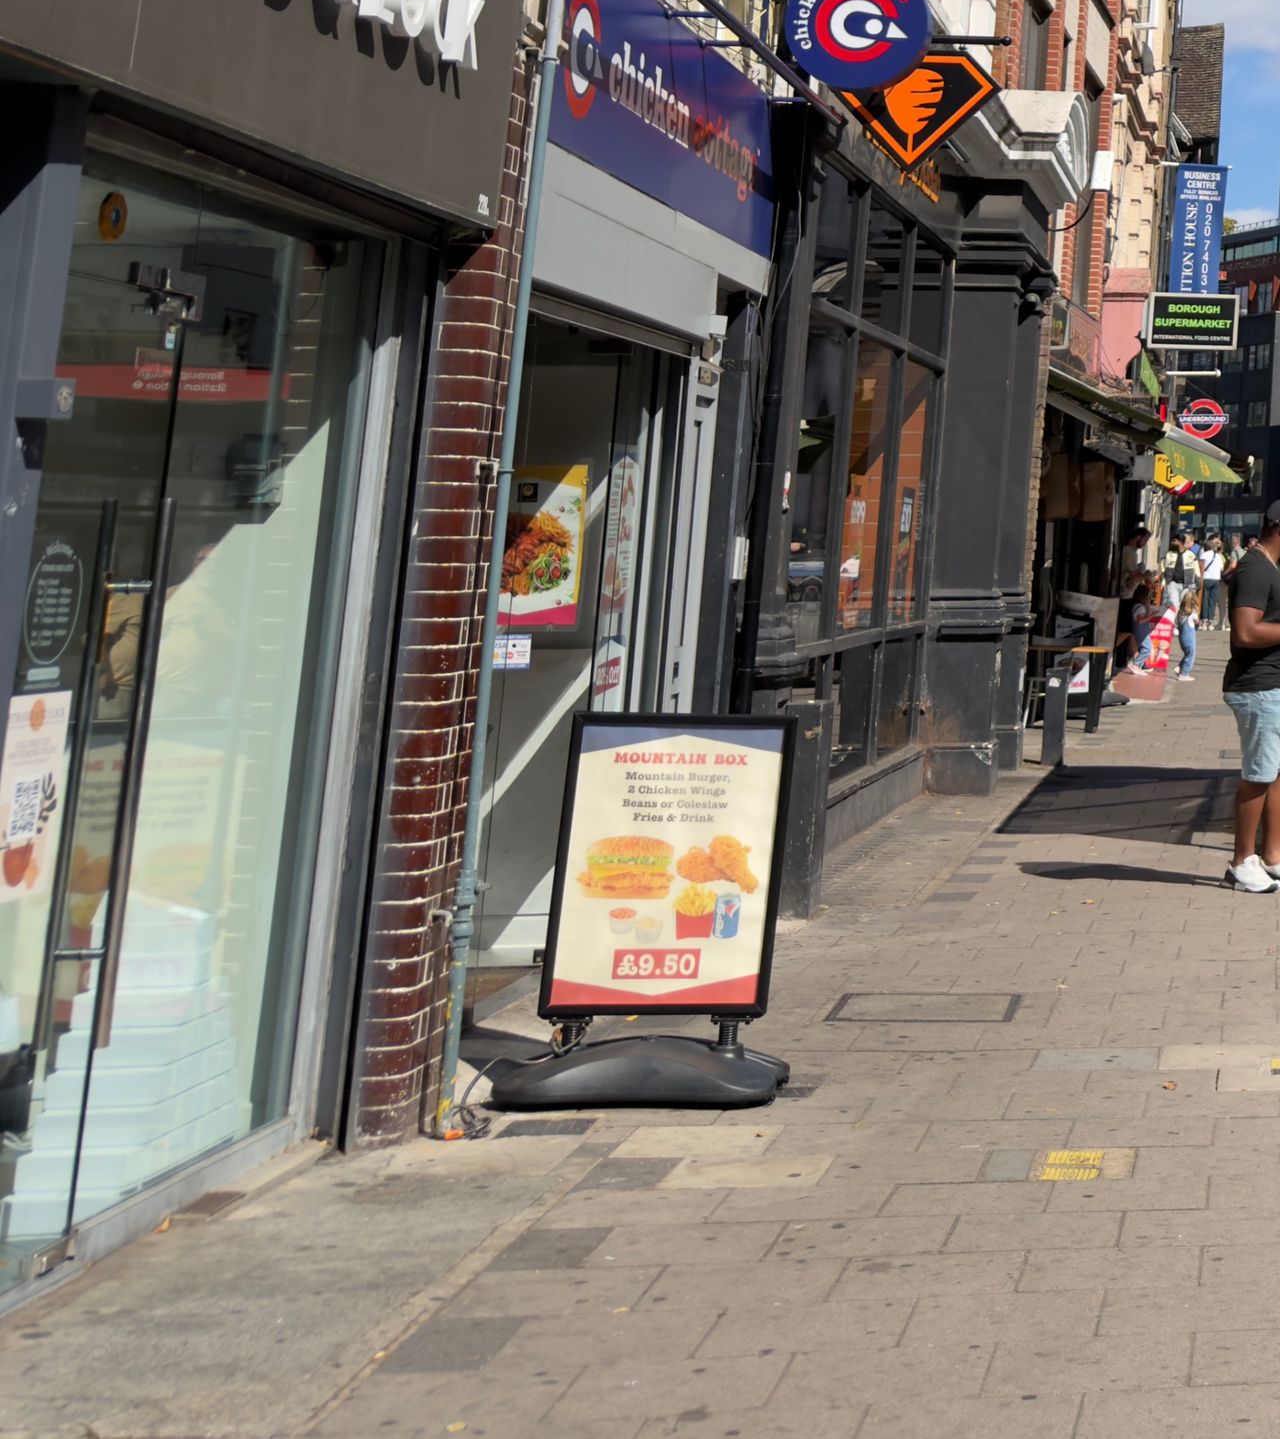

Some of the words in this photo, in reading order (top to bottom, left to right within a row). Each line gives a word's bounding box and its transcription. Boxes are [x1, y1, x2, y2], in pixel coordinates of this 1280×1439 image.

[608, 40, 691, 149] chicken
[1184, 171, 1221, 181] BUSINESS
[1187, 180, 1217, 190] CENTRE
[1184, 202, 1199, 247] HOUSE
[1204, 202, 1213, 237] 020
[1200, 240, 1211, 286] 7403
[1180, 251, 1195, 294] ITION
[1168, 303, 1221, 314] BOROUGH
[1154, 317, 1233, 329] SUPERMARKET
[613, 751, 707, 766] MOUNTAIN
[713, 753, 749, 766] BOX
[624, 771, 686, 782] Mountain
[687, 771, 732, 784] Burger,
[627, 784, 636, 795] 2
[638, 784, 687, 795] Chicken
[690, 786, 727, 798] Wings
[621, 798, 658, 809] Beans
[660, 800, 675, 809] or
[676, 799, 729, 810] Coleslaw
[632, 812, 665, 823] Fries
[666, 814, 677, 823] &
[679, 813, 715, 823] Drink
[616, 953, 696, 977] £9.50
